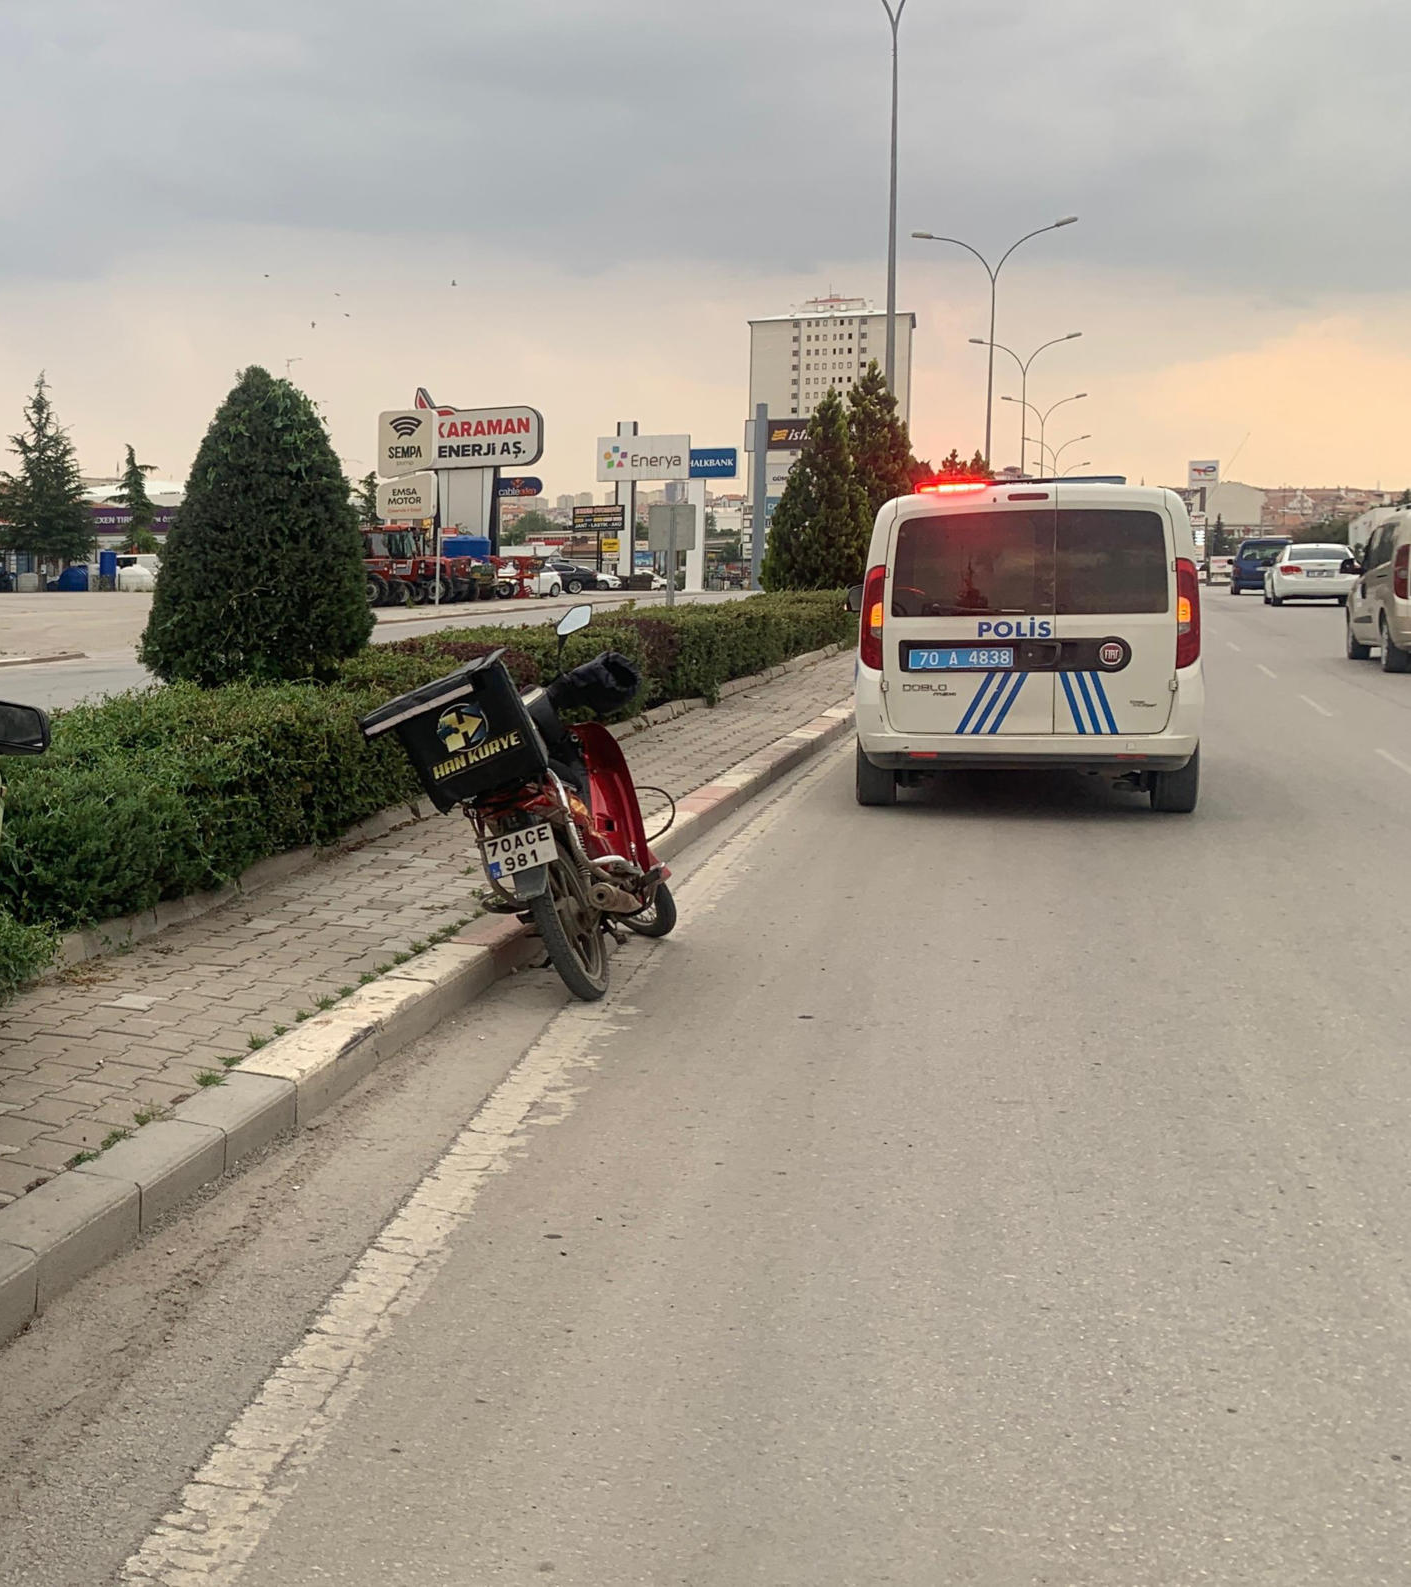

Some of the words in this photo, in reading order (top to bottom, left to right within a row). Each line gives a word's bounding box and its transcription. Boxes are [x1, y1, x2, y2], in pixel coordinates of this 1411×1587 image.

[389, 446, 423, 459] SEMPA
[631, 454, 682, 469] Enerya
[392, 488, 418, 496] EMSA
[388, 497, 422, 505] MOTOR
[978, 617, 1051, 638] POLİS
[919, 652, 939, 666] 70
[949, 652, 958, 665] A
[969, 650, 1010, 664] 4838
[1105, 649, 1119, 659] FIAT
[902, 684, 947, 692] DOBLO
[432, 754, 466, 780] HAN
[468, 731, 520, 764] KURYE
[504, 849, 538, 871] 981
